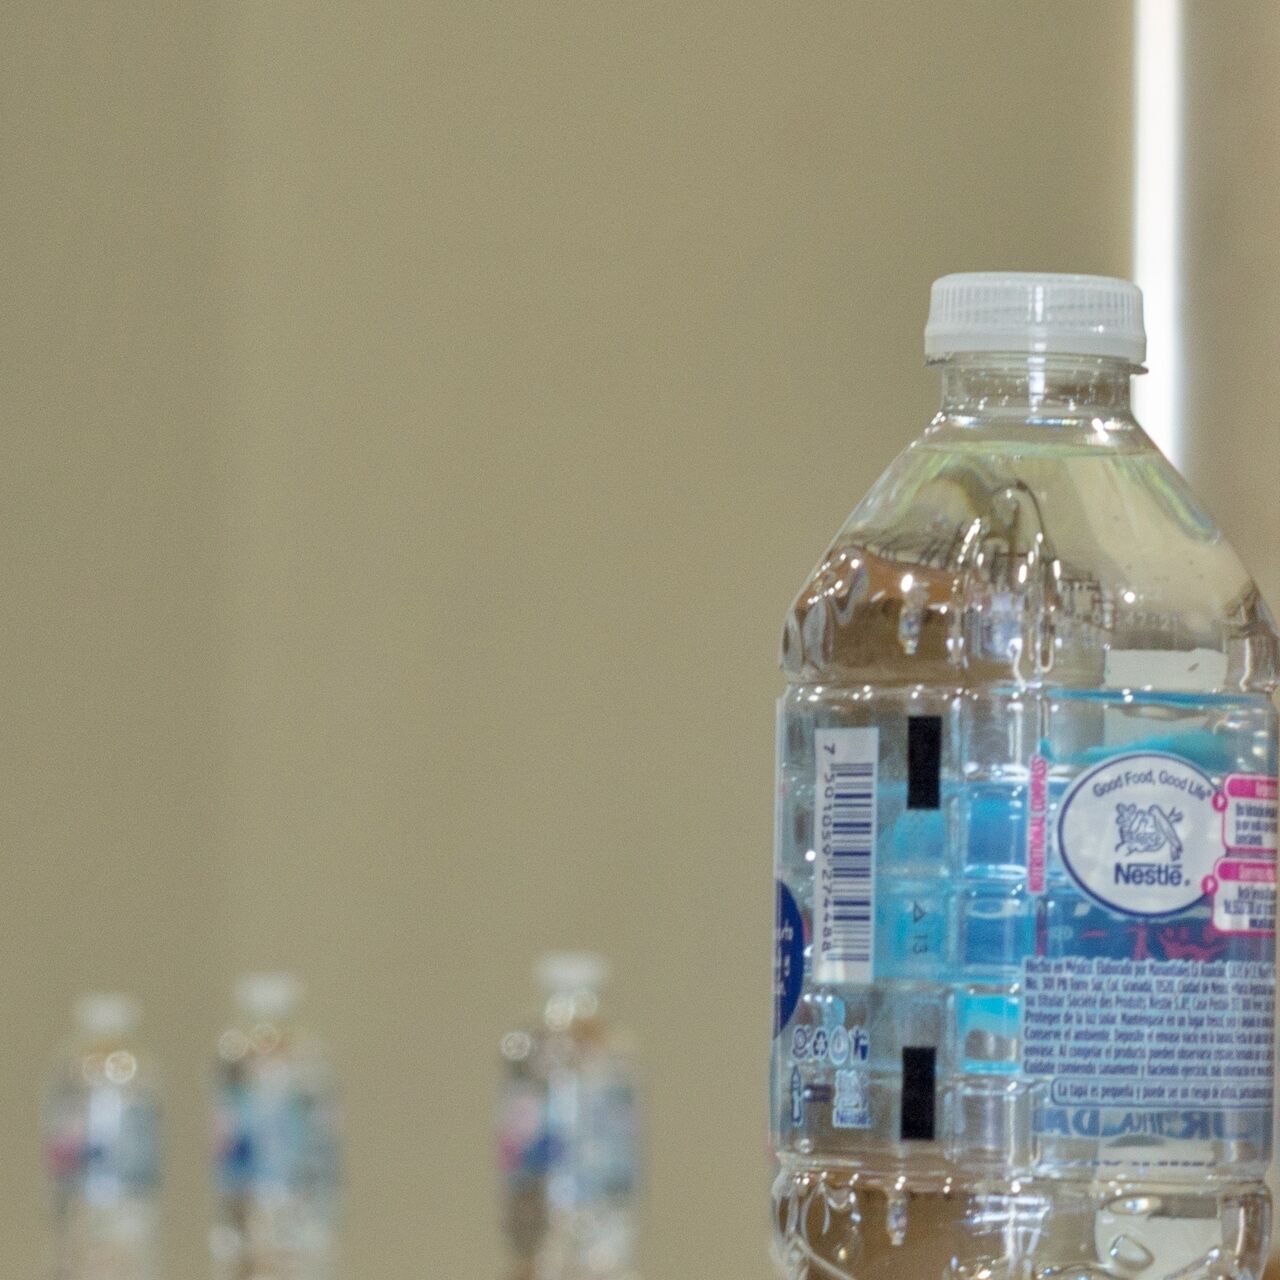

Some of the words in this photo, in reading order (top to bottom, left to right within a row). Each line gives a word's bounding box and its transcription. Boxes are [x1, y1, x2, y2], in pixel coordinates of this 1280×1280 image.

[1092, 775, 1123, 798] Good
[1125, 770, 1156, 786] Food,
[1158, 770, 1187, 789] Good
[1029, 815, 1046, 892] NUTRITIONAL
[1114, 862, 1184, 886] Nestlé
